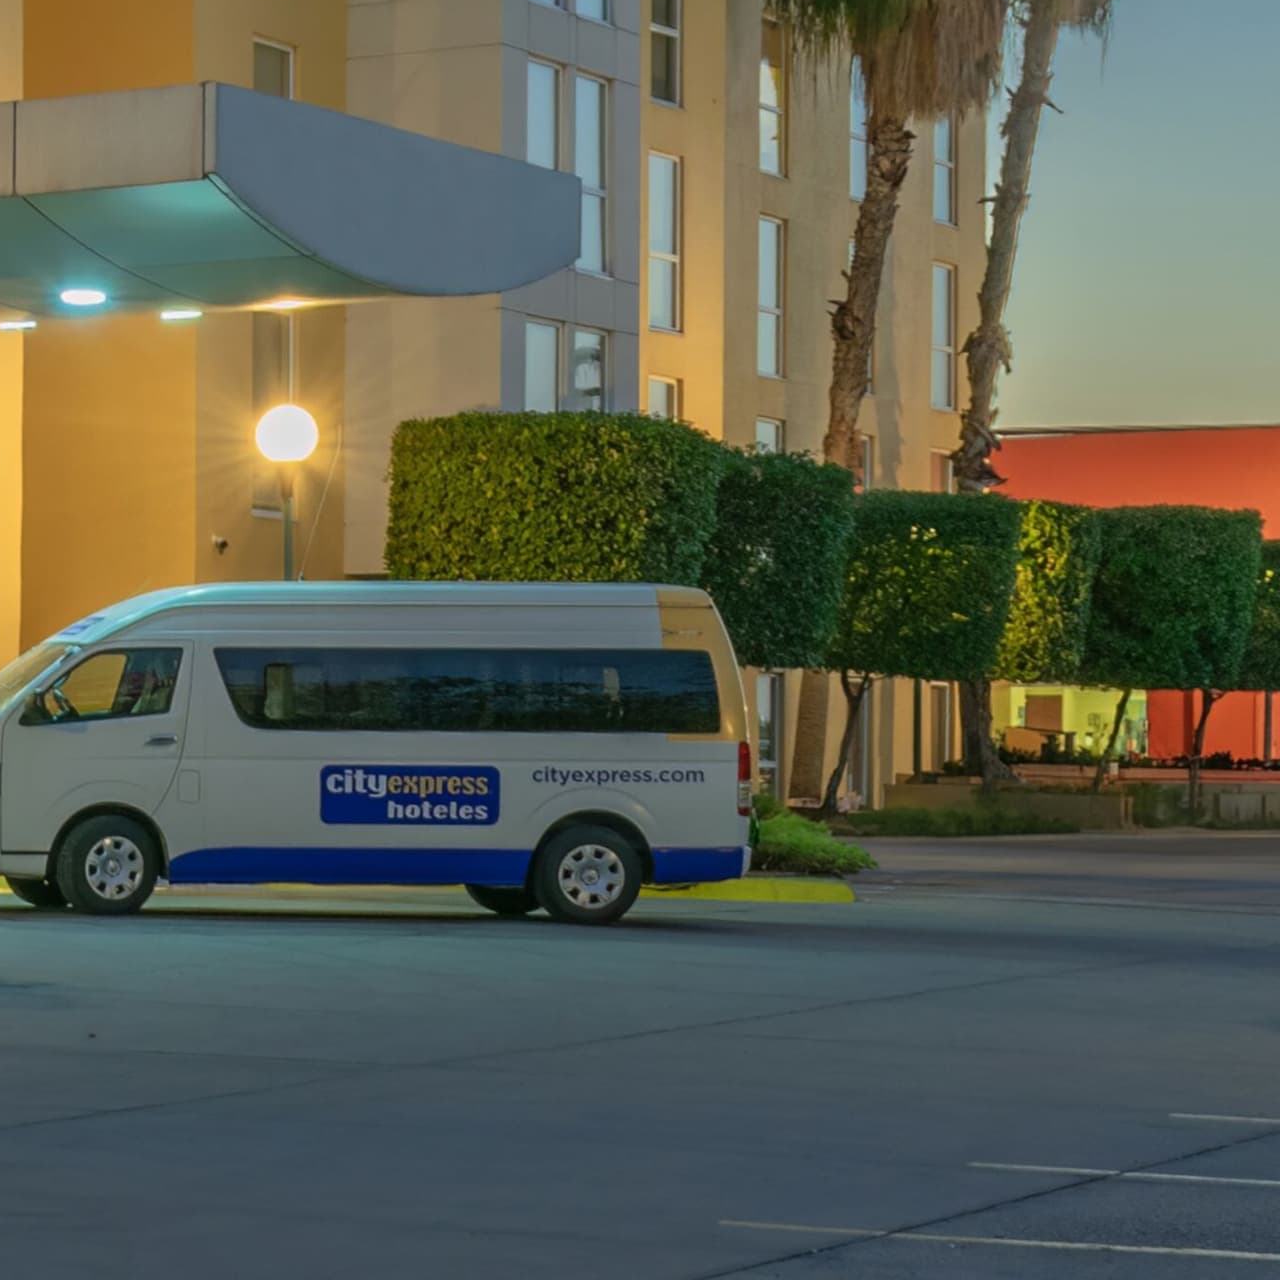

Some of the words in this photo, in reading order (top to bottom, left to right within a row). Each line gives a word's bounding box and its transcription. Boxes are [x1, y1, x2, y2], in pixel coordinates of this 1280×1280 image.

[326, 769, 489, 798] cityexpress
[532, 766, 705, 786] cityexpress.com
[387, 801, 489, 820] hoteles
